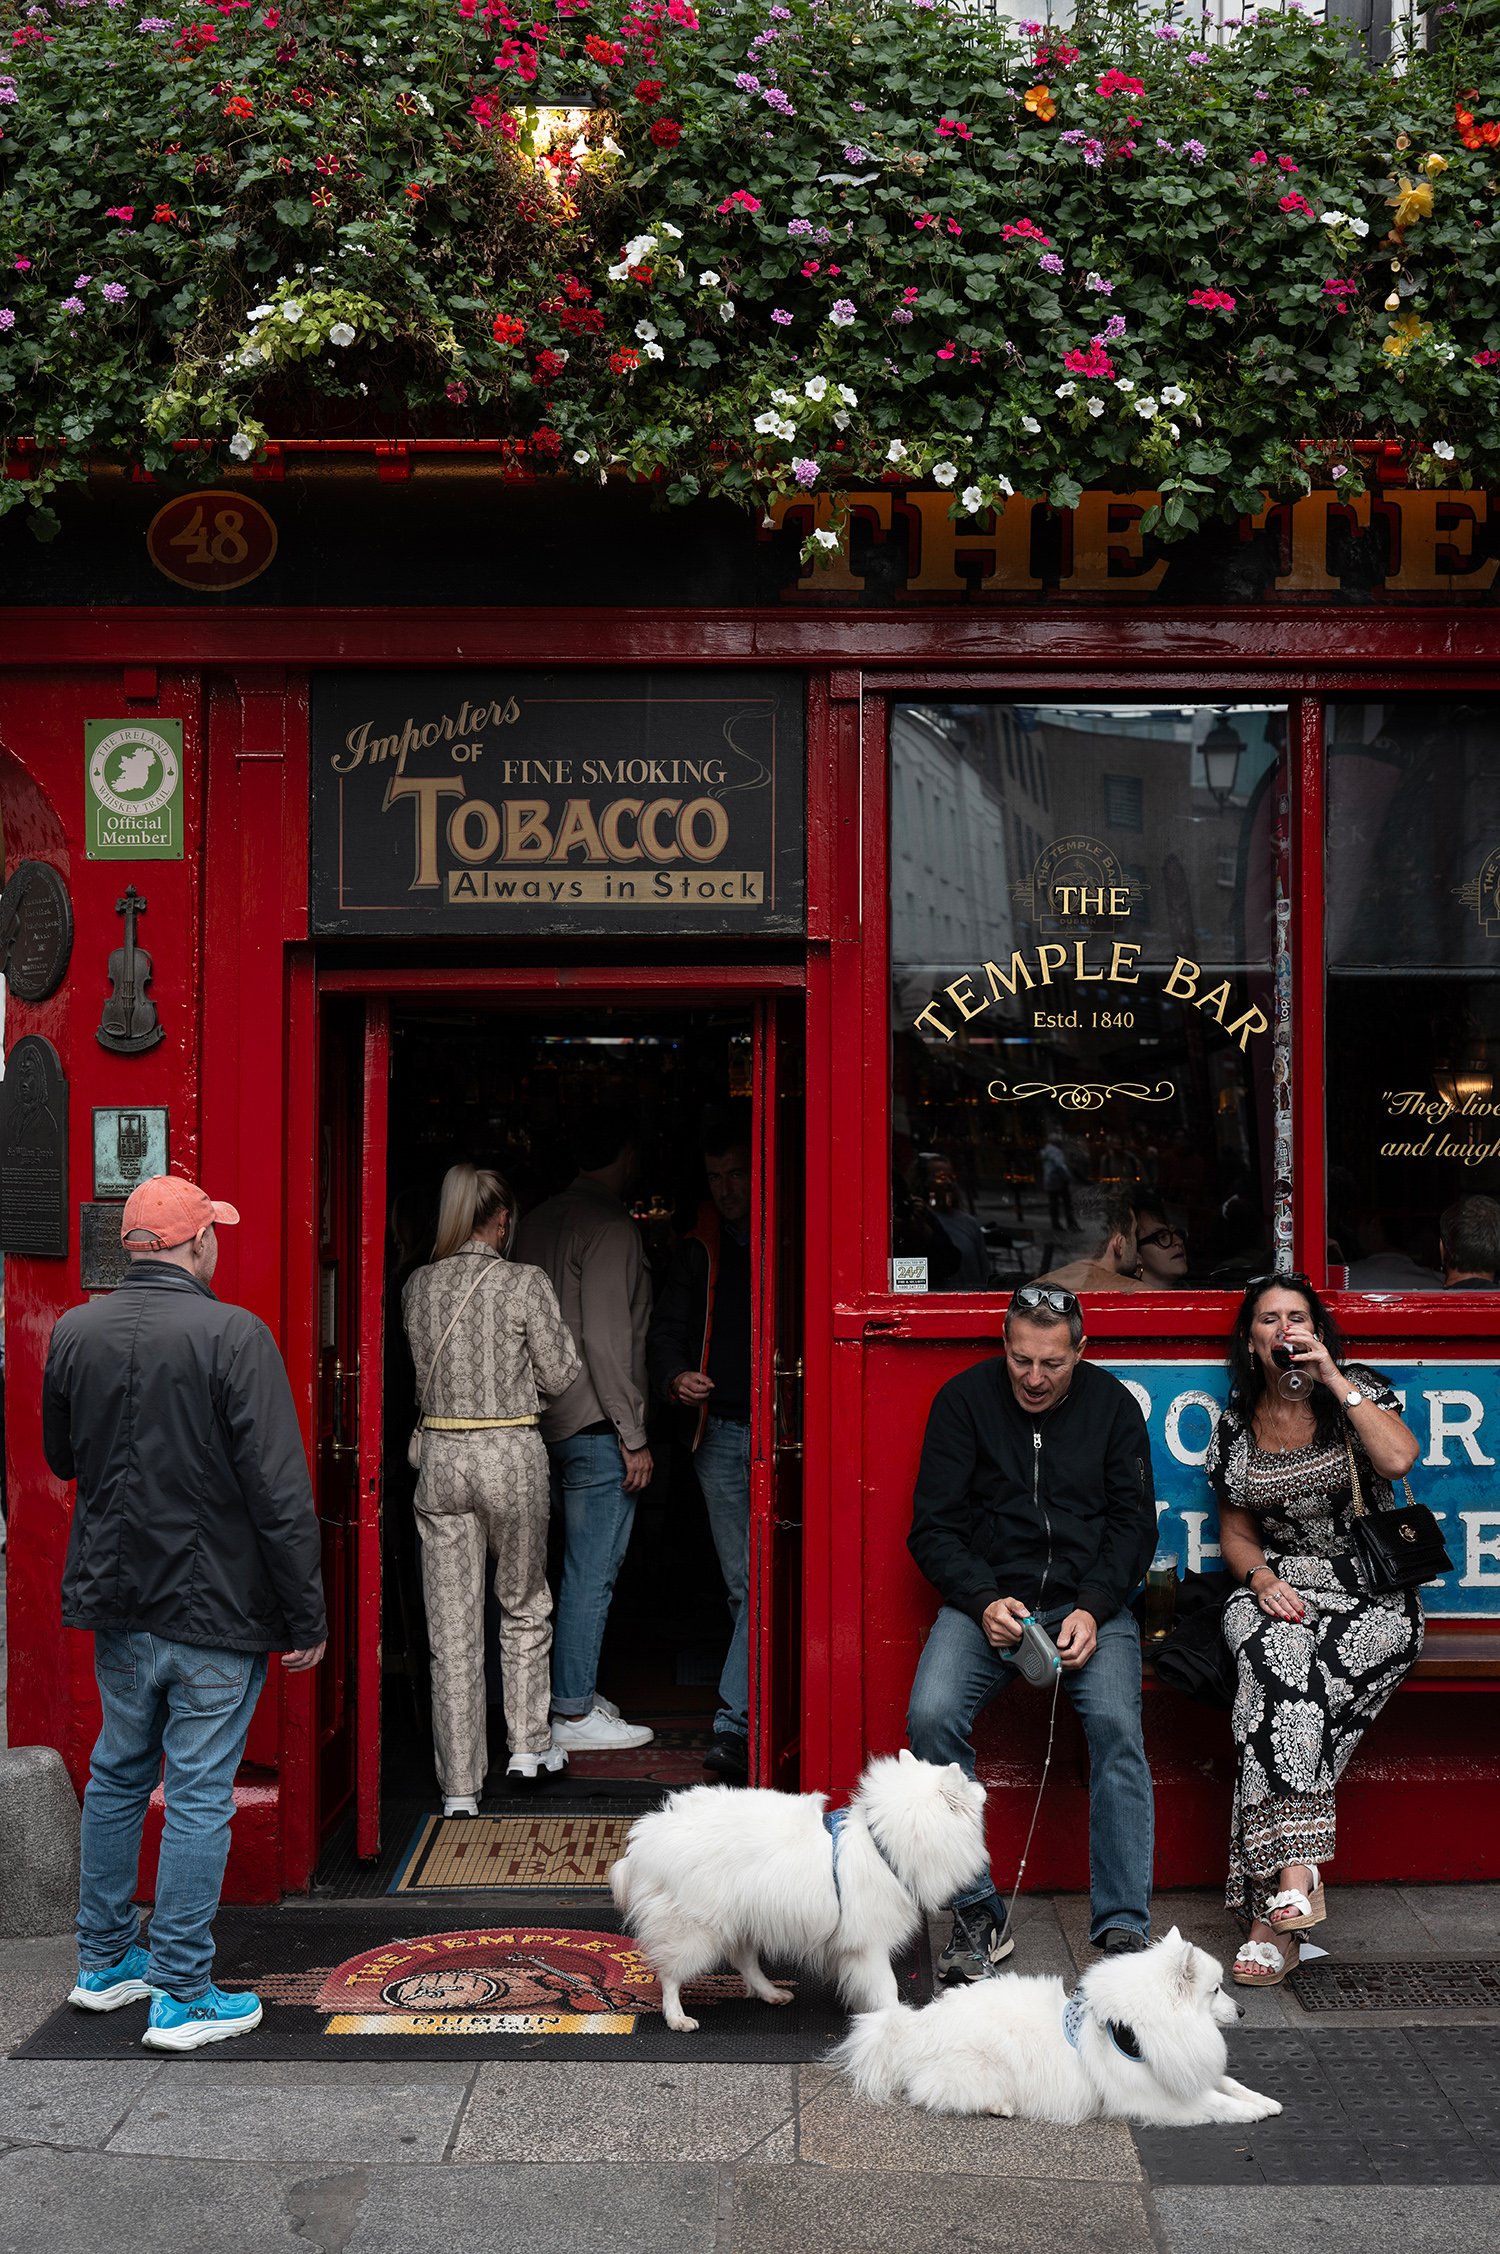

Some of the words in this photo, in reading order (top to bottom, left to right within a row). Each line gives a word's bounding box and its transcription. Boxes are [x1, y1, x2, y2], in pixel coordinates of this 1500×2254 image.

[169, 505, 250, 565] 48
[769, 491, 1170, 591] THE
[97, 738, 120, 758] THE
[120, 731, 169, 758] IRELAND
[330, 696, 521, 775] Importers
[451, 744, 484, 762] OF
[502, 759, 573, 785] FINE
[581, 758, 728, 785] SMOKING
[98, 785, 140, 813] WHISKEY
[142, 789, 170, 811] TRAIL
[107, 816, 162, 830] Official
[382, 774, 730, 891] TOBACCO
[102, 831, 167, 844] Member
[1037, 858, 1052, 890] THE
[1050, 841, 1104, 859] TEMPLE
[453, 871, 584, 901] Always
[605, 875, 636, 898] in
[650, 870, 757, 899] Stock
[1054, 886, 1132, 916] THE
[1059, 918, 1098, 926] DUBLIN
[912, 940, 1143, 1044] TEMPLE
[1161, 955, 1270, 1053] BAR
[1033, 1010, 1084, 1029] Estd.
[1091, 1011, 1135, 1030] 1840
[1382, 1091, 1457, 1125] "They
[1380, 1132, 1435, 1157] and
[440, 1841, 622, 1858] TEMP
[345, 1953, 417, 1987] THE
[407, 1934, 617, 1954] TEMPLE
[186, 2006, 218, 2020] HOKA
